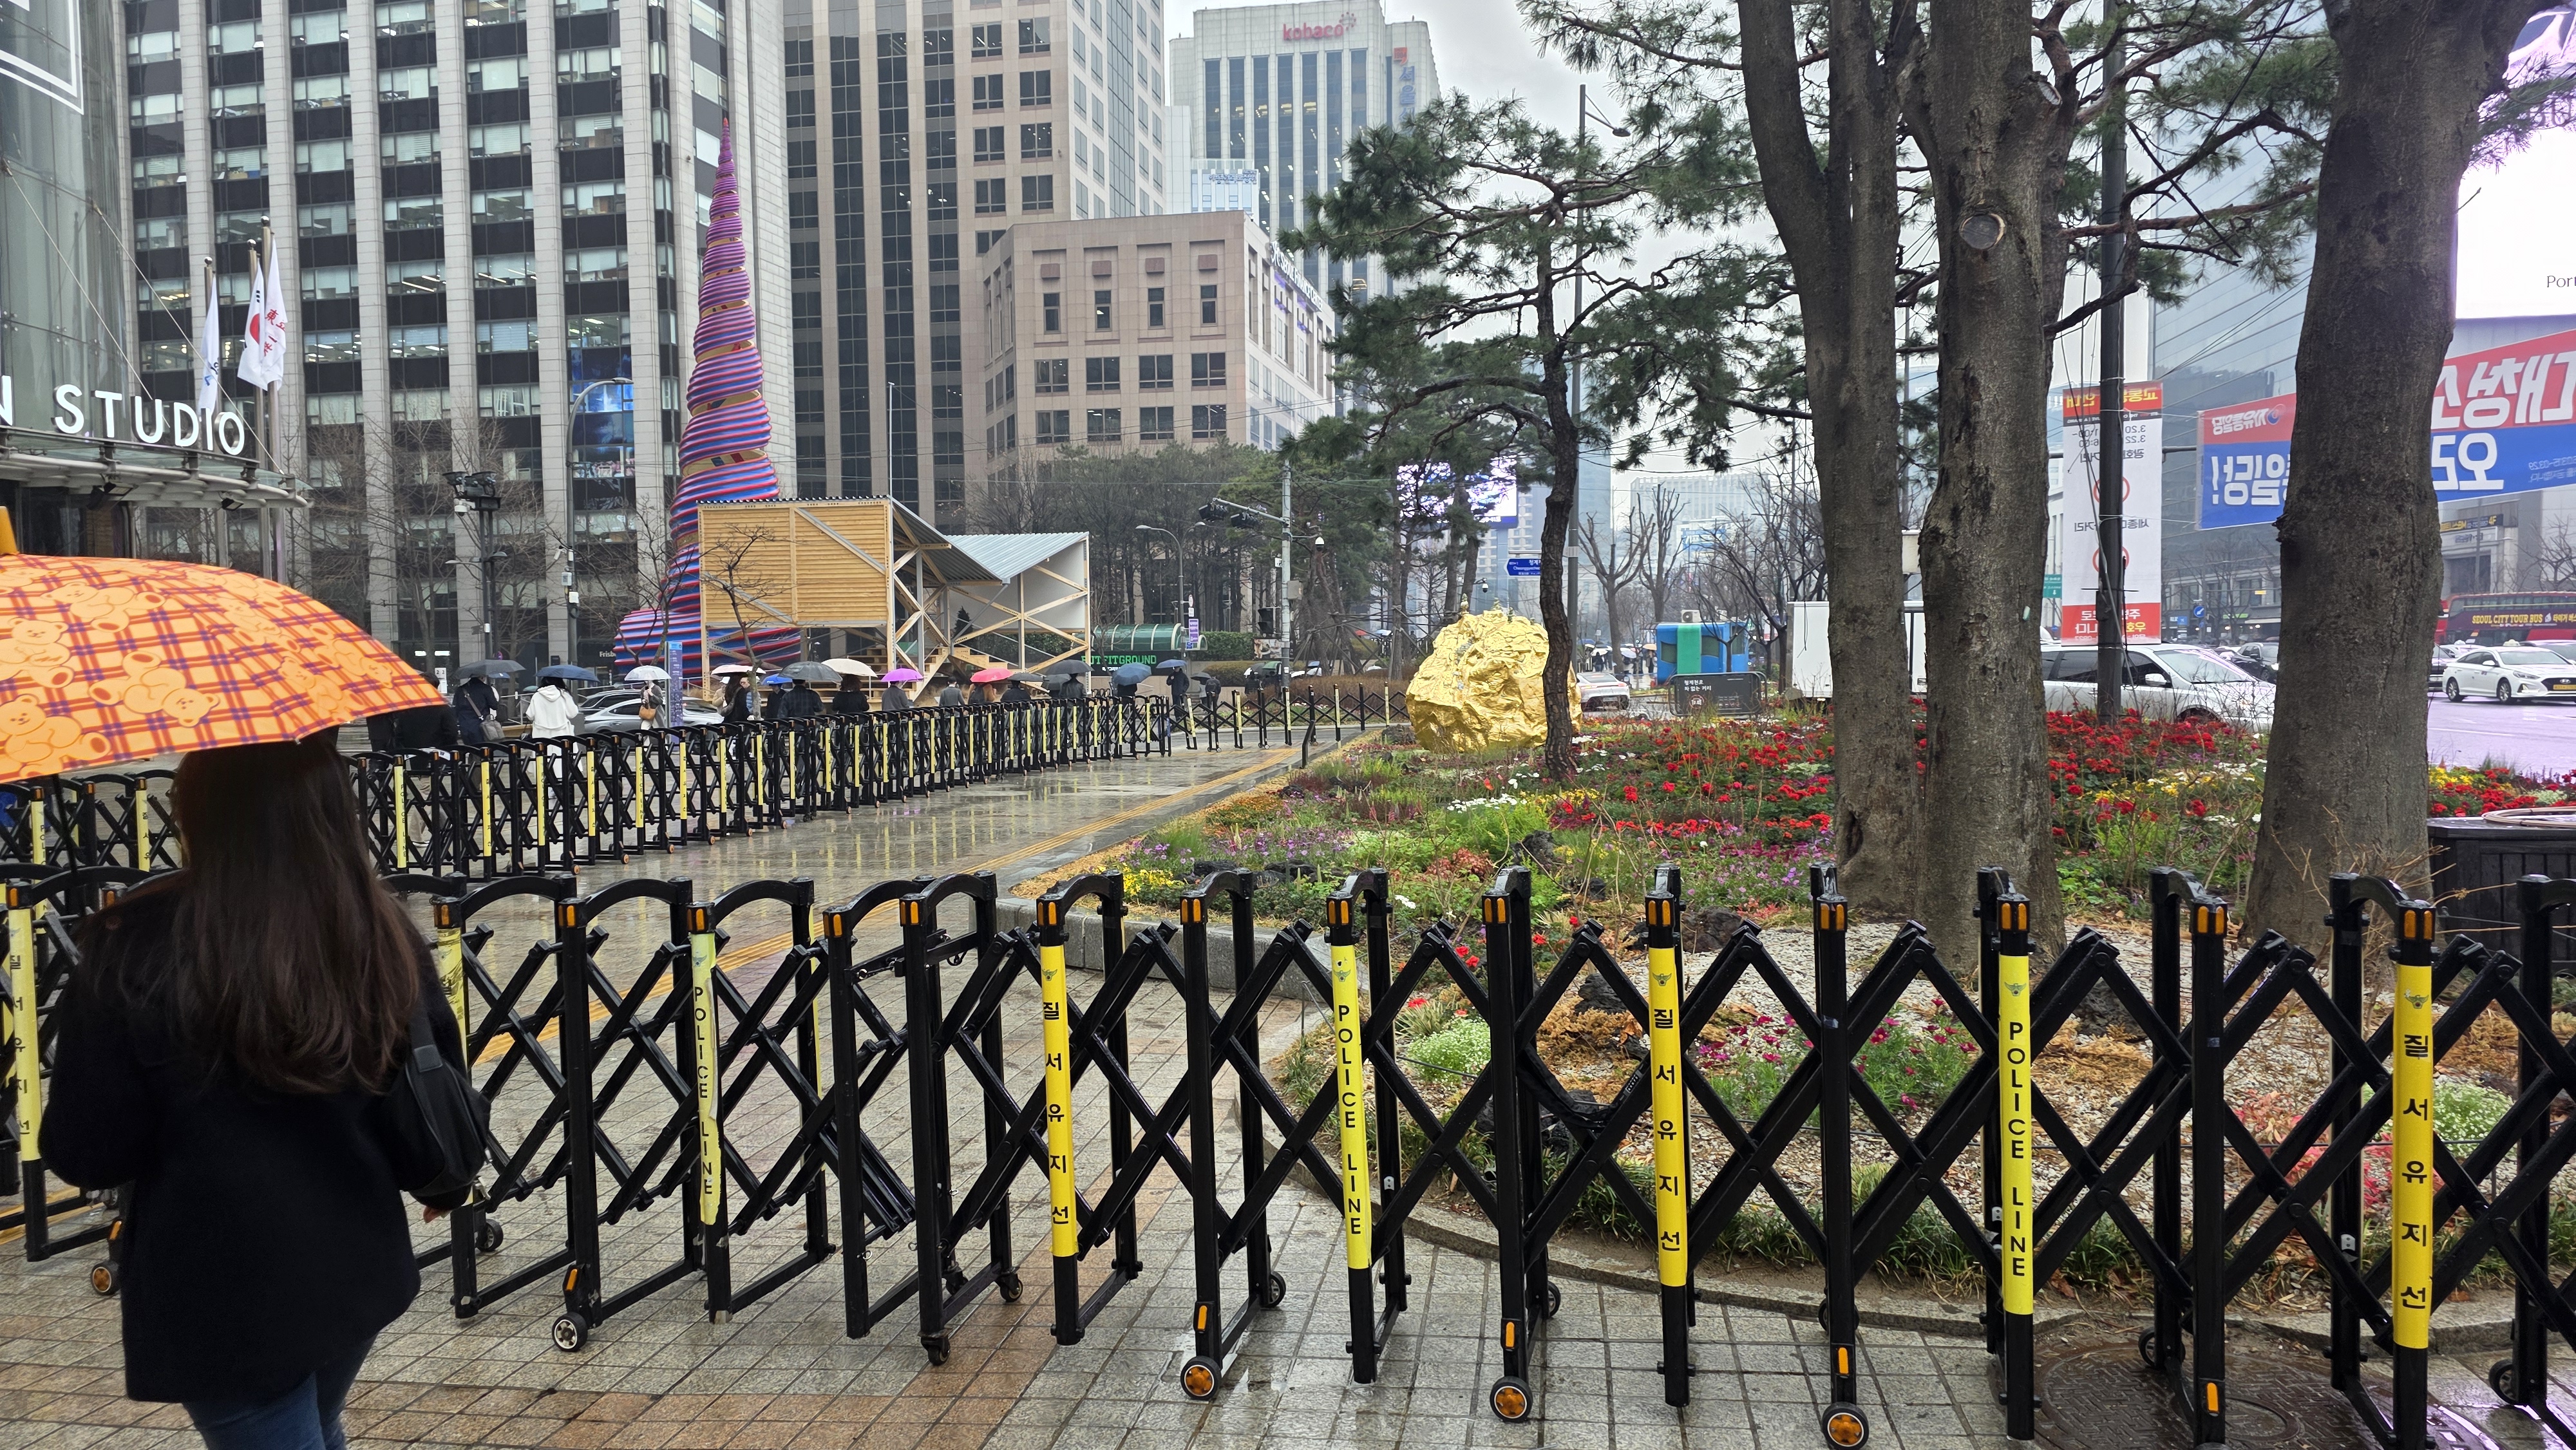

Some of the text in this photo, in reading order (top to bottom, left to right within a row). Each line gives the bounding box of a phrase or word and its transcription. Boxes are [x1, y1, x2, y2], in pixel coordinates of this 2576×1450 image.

[1283, 22, 1344, 41] kobaco
[52, 384, 245, 456] STUDIO
[2472, 614, 2543, 624] SEOUL CITY TOUR BUS
[694, 986, 713, 1195] POLICE LINE
[1042, 1001, 1070, 1225] 질서유지선
[1338, 1004, 1361, 1235] POLICE LINE
[1653, 1008, 1681, 1252] 질서유지선
[2007, 1022, 2027, 1277] POLICE LINE
[2400, 1033, 2430, 1310] 질서유지선
